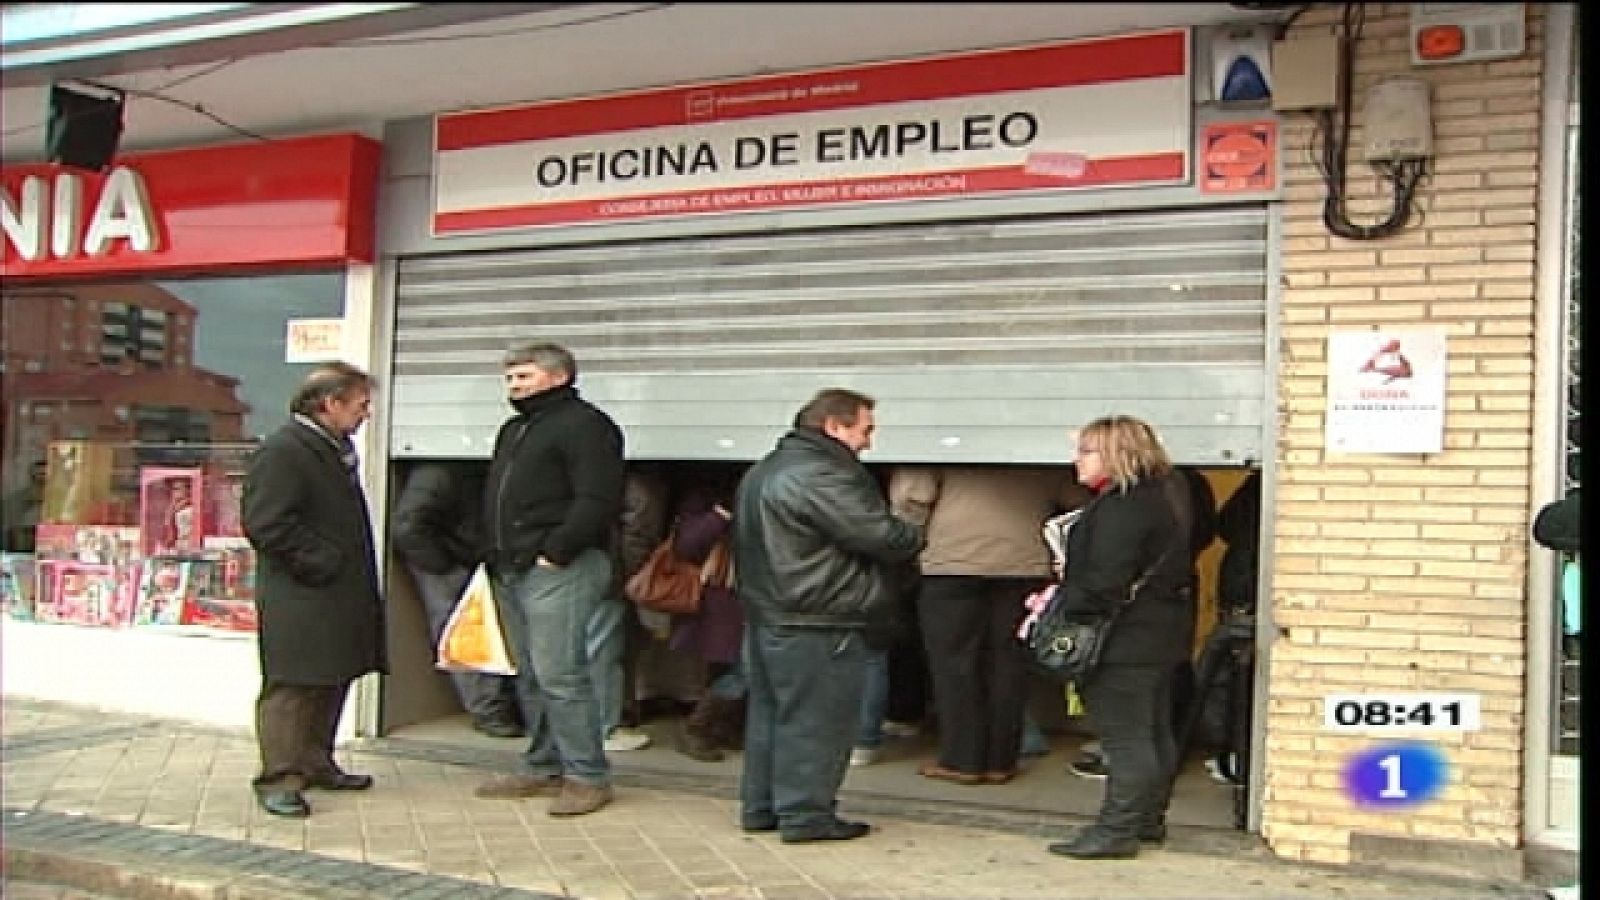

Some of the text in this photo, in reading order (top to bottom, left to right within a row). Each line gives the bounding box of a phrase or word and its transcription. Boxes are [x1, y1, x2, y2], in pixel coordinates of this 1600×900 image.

[537, 142, 718, 188] OFICINA
[734, 133, 799, 169] DE
[816, 111, 1038, 163] EMPLEO
